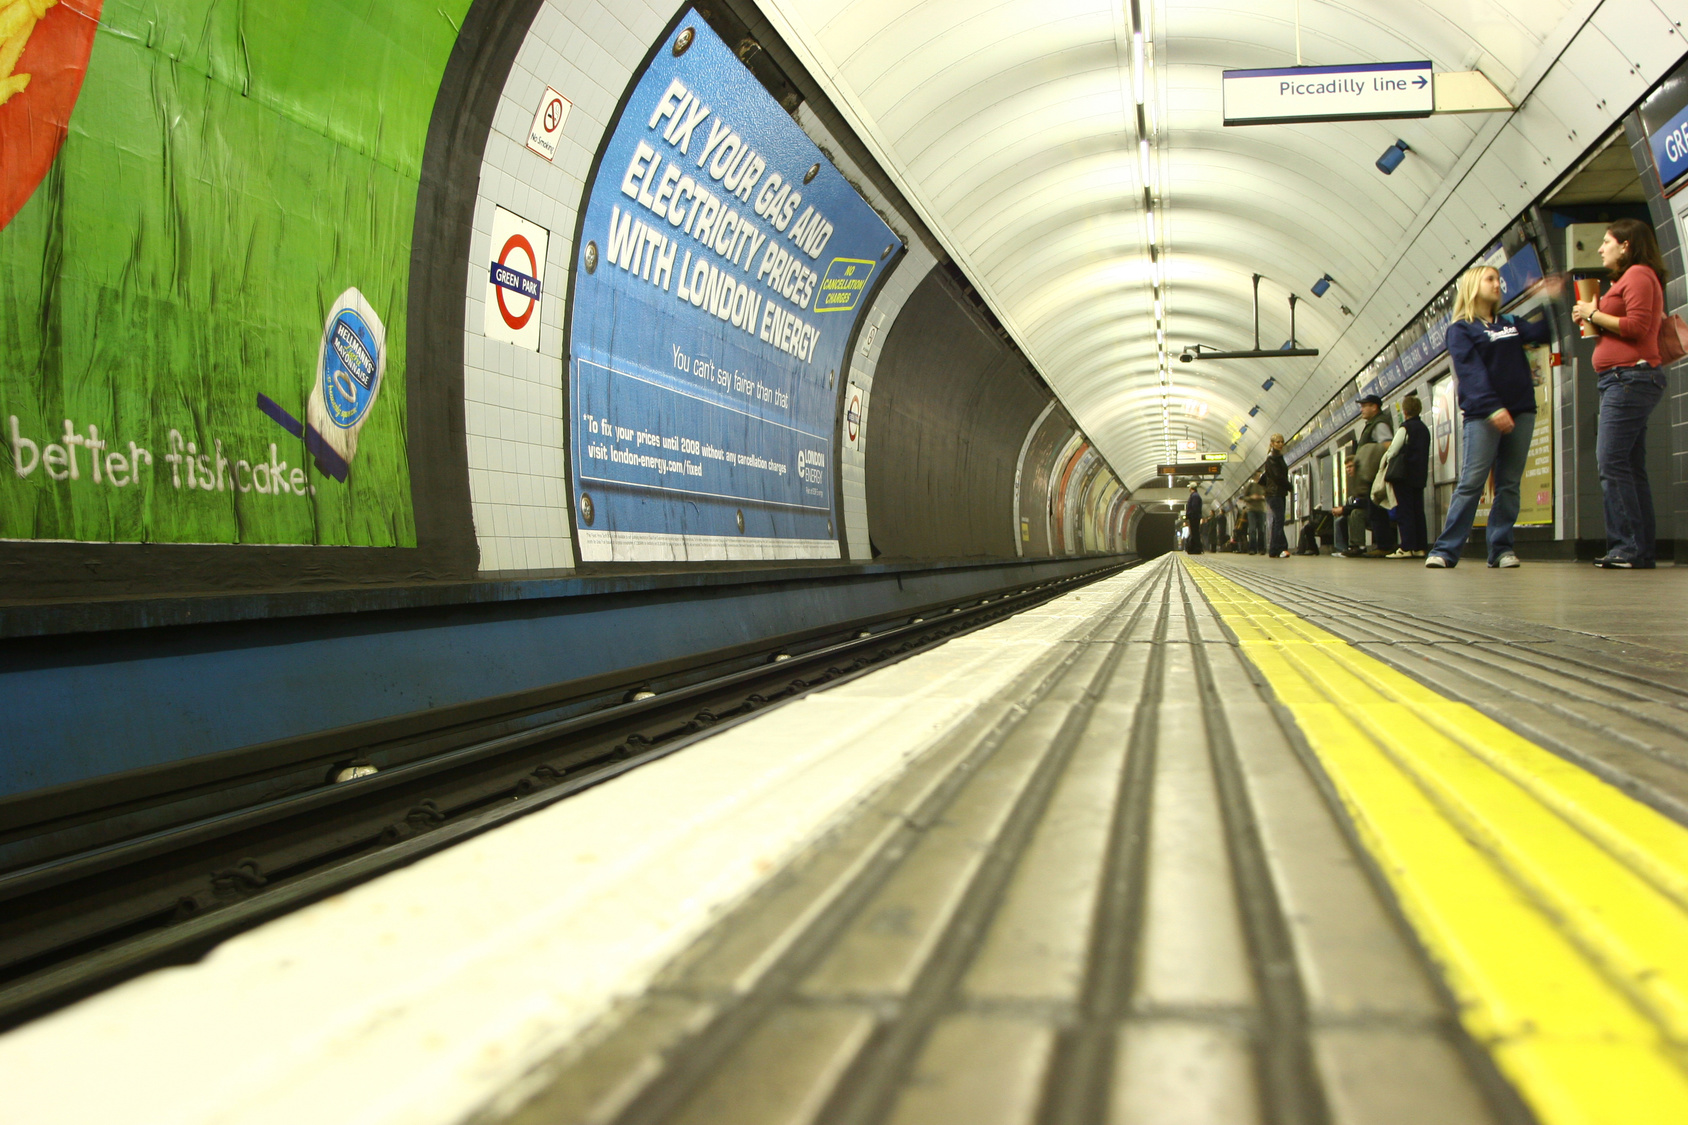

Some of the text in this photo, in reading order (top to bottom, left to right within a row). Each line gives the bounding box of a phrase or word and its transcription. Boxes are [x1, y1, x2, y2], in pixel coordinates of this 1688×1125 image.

[1280, 77, 1407, 96] Piccadilly line
[531, 132, 554, 155] No Smoking
[649, 78, 834, 260] FIX YOUR GAS AND
[621, 140, 818, 310] ELECTRICITY PRICES
[496, 269, 538, 296] GREEN PARK
[844, 266, 856, 276] NO
[607, 206, 820, 364] WITH LONDON ENERGY
[823, 279, 865, 290] CANCELLATION
[825, 293, 851, 304] CHARGES
[334, 337, 369, 385] MAYONNAISE
[672, 343, 789, 409] You can't say fairer than that
[9, 414, 152, 488] better
[588, 441, 608, 460] visit
[601, 418, 612, 437] fix
[615, 425, 634, 442] your
[637, 429, 660, 447] prices
[662, 436, 679, 452] until
[681, 437, 700, 455] 2008
[702, 443, 725, 461] without
[725, 451, 736, 466] any
[737, 454, 767, 470] cancellation
[768, 459, 787, 475] charges
[805, 449, 825, 467] LONDON
[805, 467, 822, 484] ENERGY
